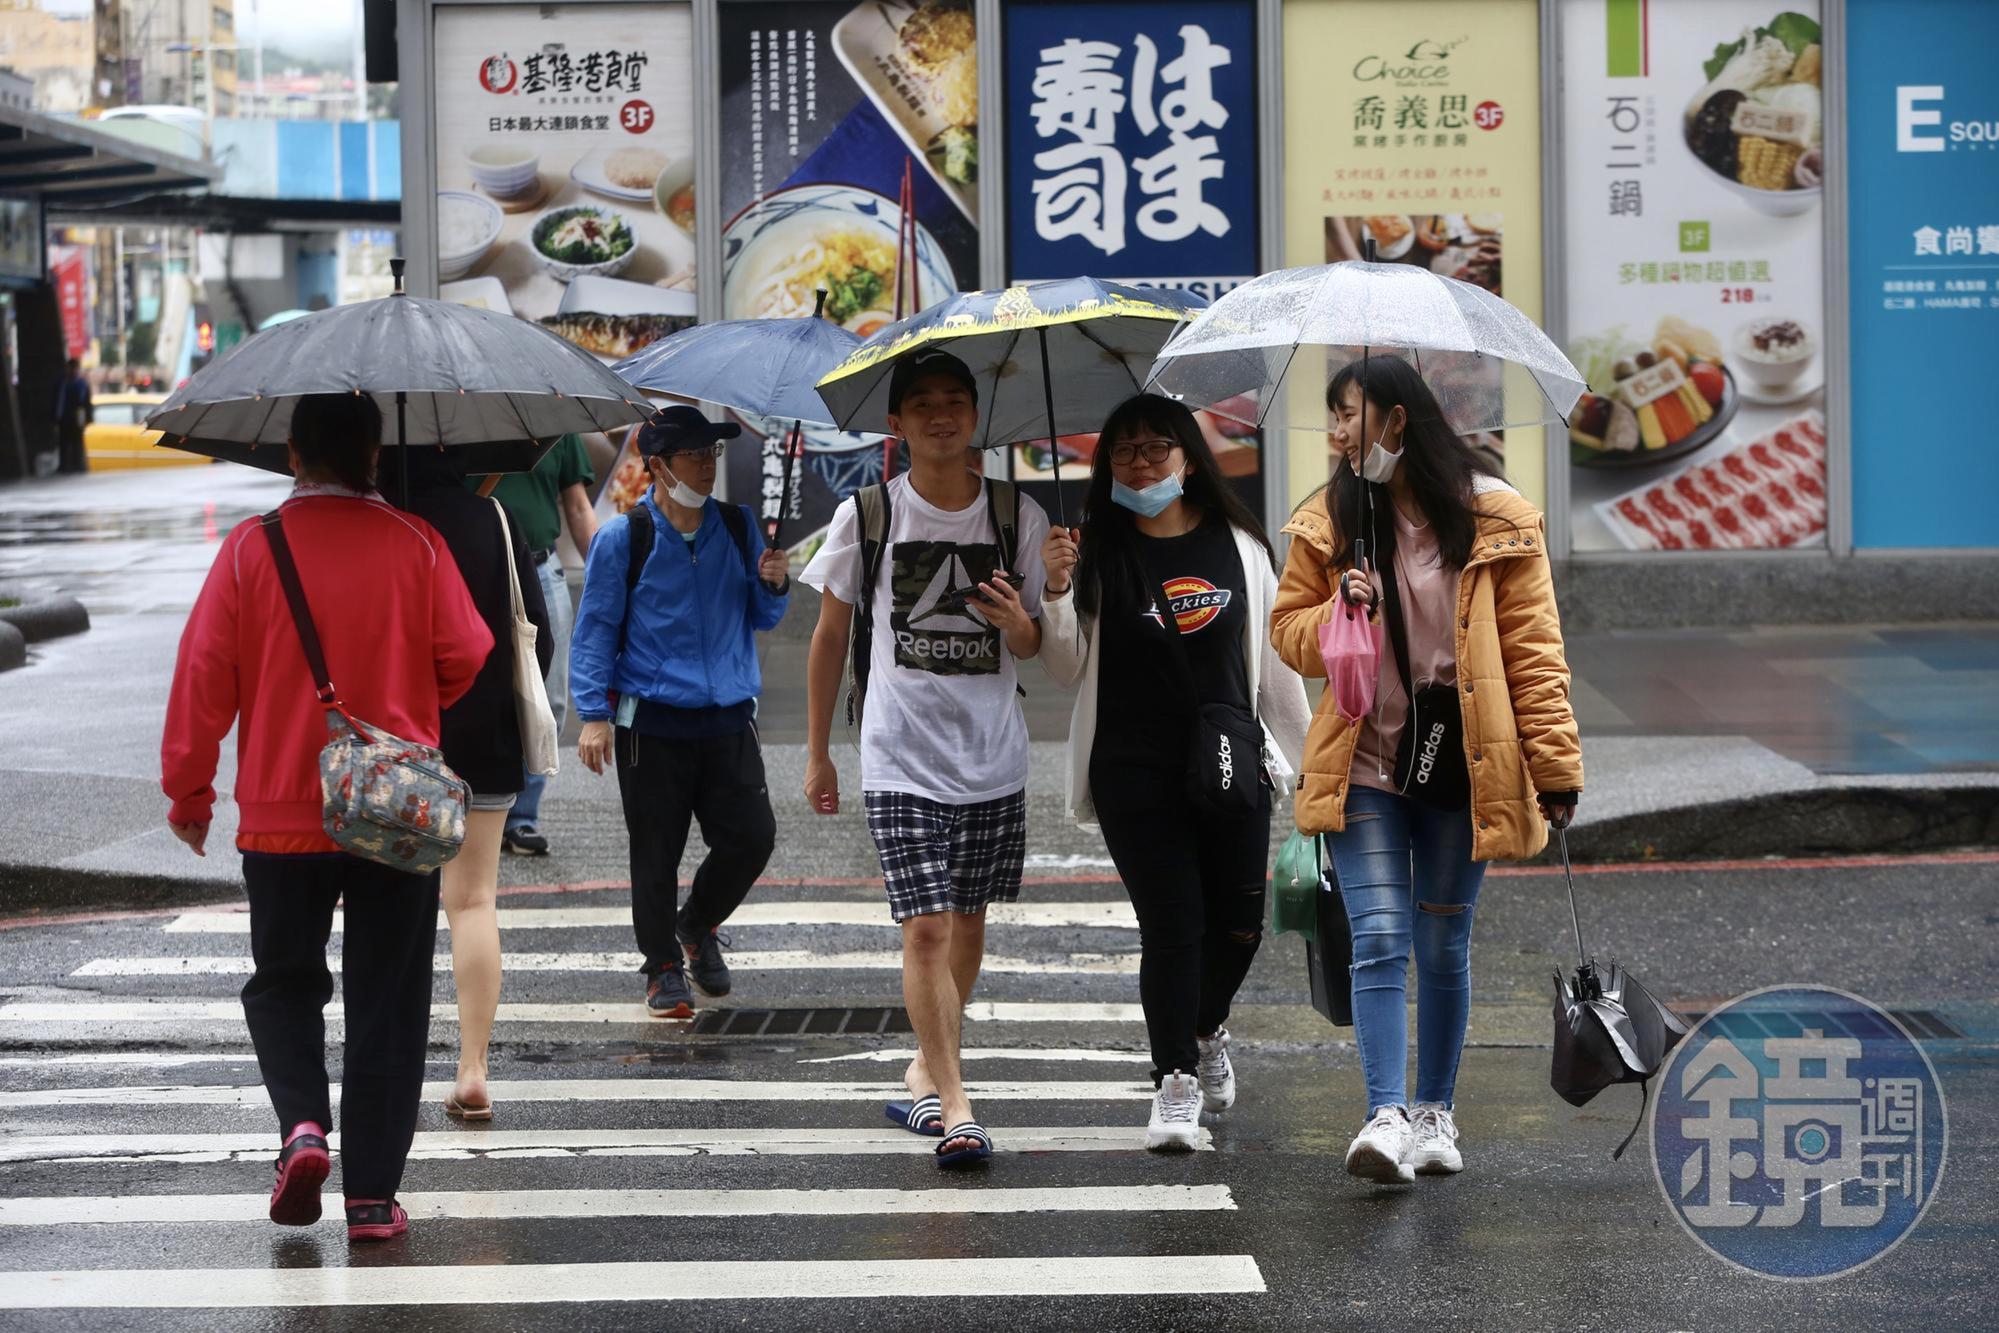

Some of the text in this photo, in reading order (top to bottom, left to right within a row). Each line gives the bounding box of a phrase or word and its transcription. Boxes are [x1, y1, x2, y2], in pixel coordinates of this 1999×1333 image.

[522, 50, 648, 94] 基隆港食堂
[1353, 55, 1449, 81] Choice
[489, 115, 610, 131] 日本最大連鎖食堂
[624, 107, 650, 127] 3F
[1354, 95, 1469, 130] 喬義思
[1476, 106, 1503, 126] 3F
[1896, 85, 1945, 152] E
[1606, 97, 1643, 217] 石二鍋
[1683, 231, 1706, 246] 3F
[1721, 288, 1755, 304] 218
[896, 630, 995, 660] Reebok
[1217, 734, 1233, 790] adidas
[1417, 722, 1445, 784] adidas
